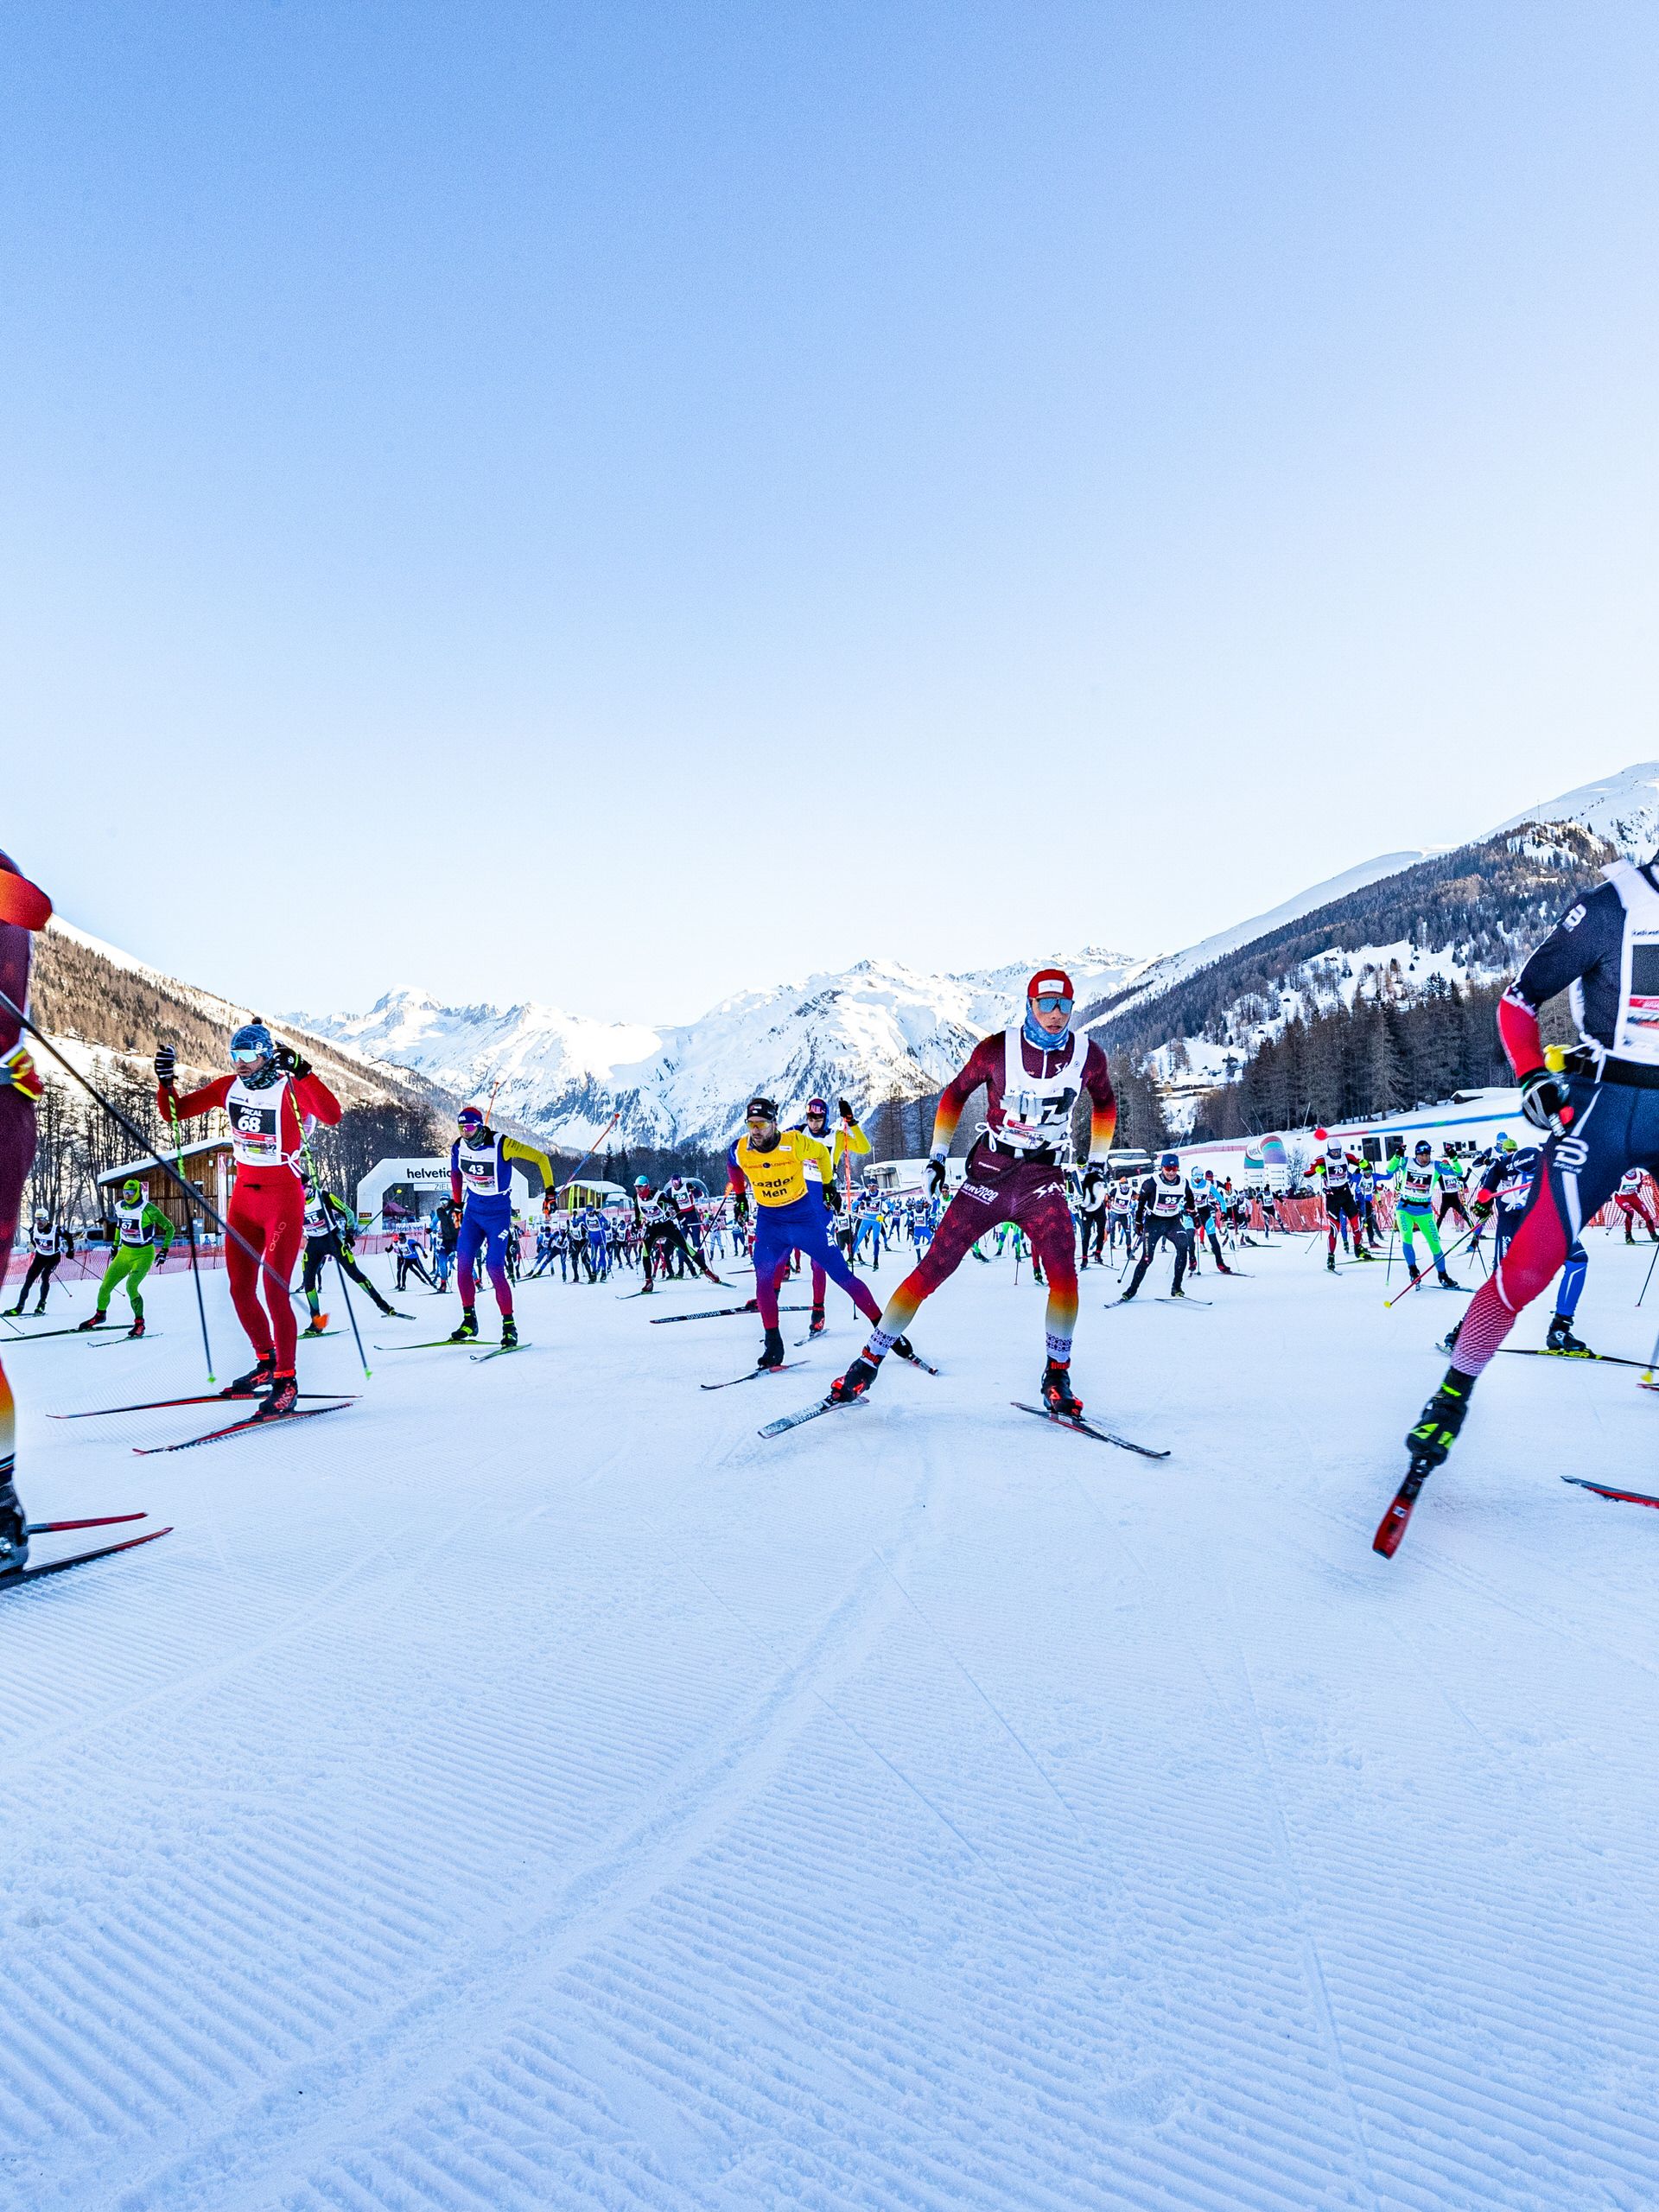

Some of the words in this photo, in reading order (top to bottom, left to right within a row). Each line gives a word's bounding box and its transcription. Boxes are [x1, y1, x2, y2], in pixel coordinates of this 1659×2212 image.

[238, 1115, 261, 1133] 68
[468, 1164, 484, 1175] 43
[753, 1176, 794, 1189] Leader
[1412, 1176, 1424, 1185] 71
[761, 1187, 788, 1198] Men
[1165, 1196, 1177, 1205] 95
[306, 1215, 320, 1224] 15
[121, 1222, 132, 1230] 67
